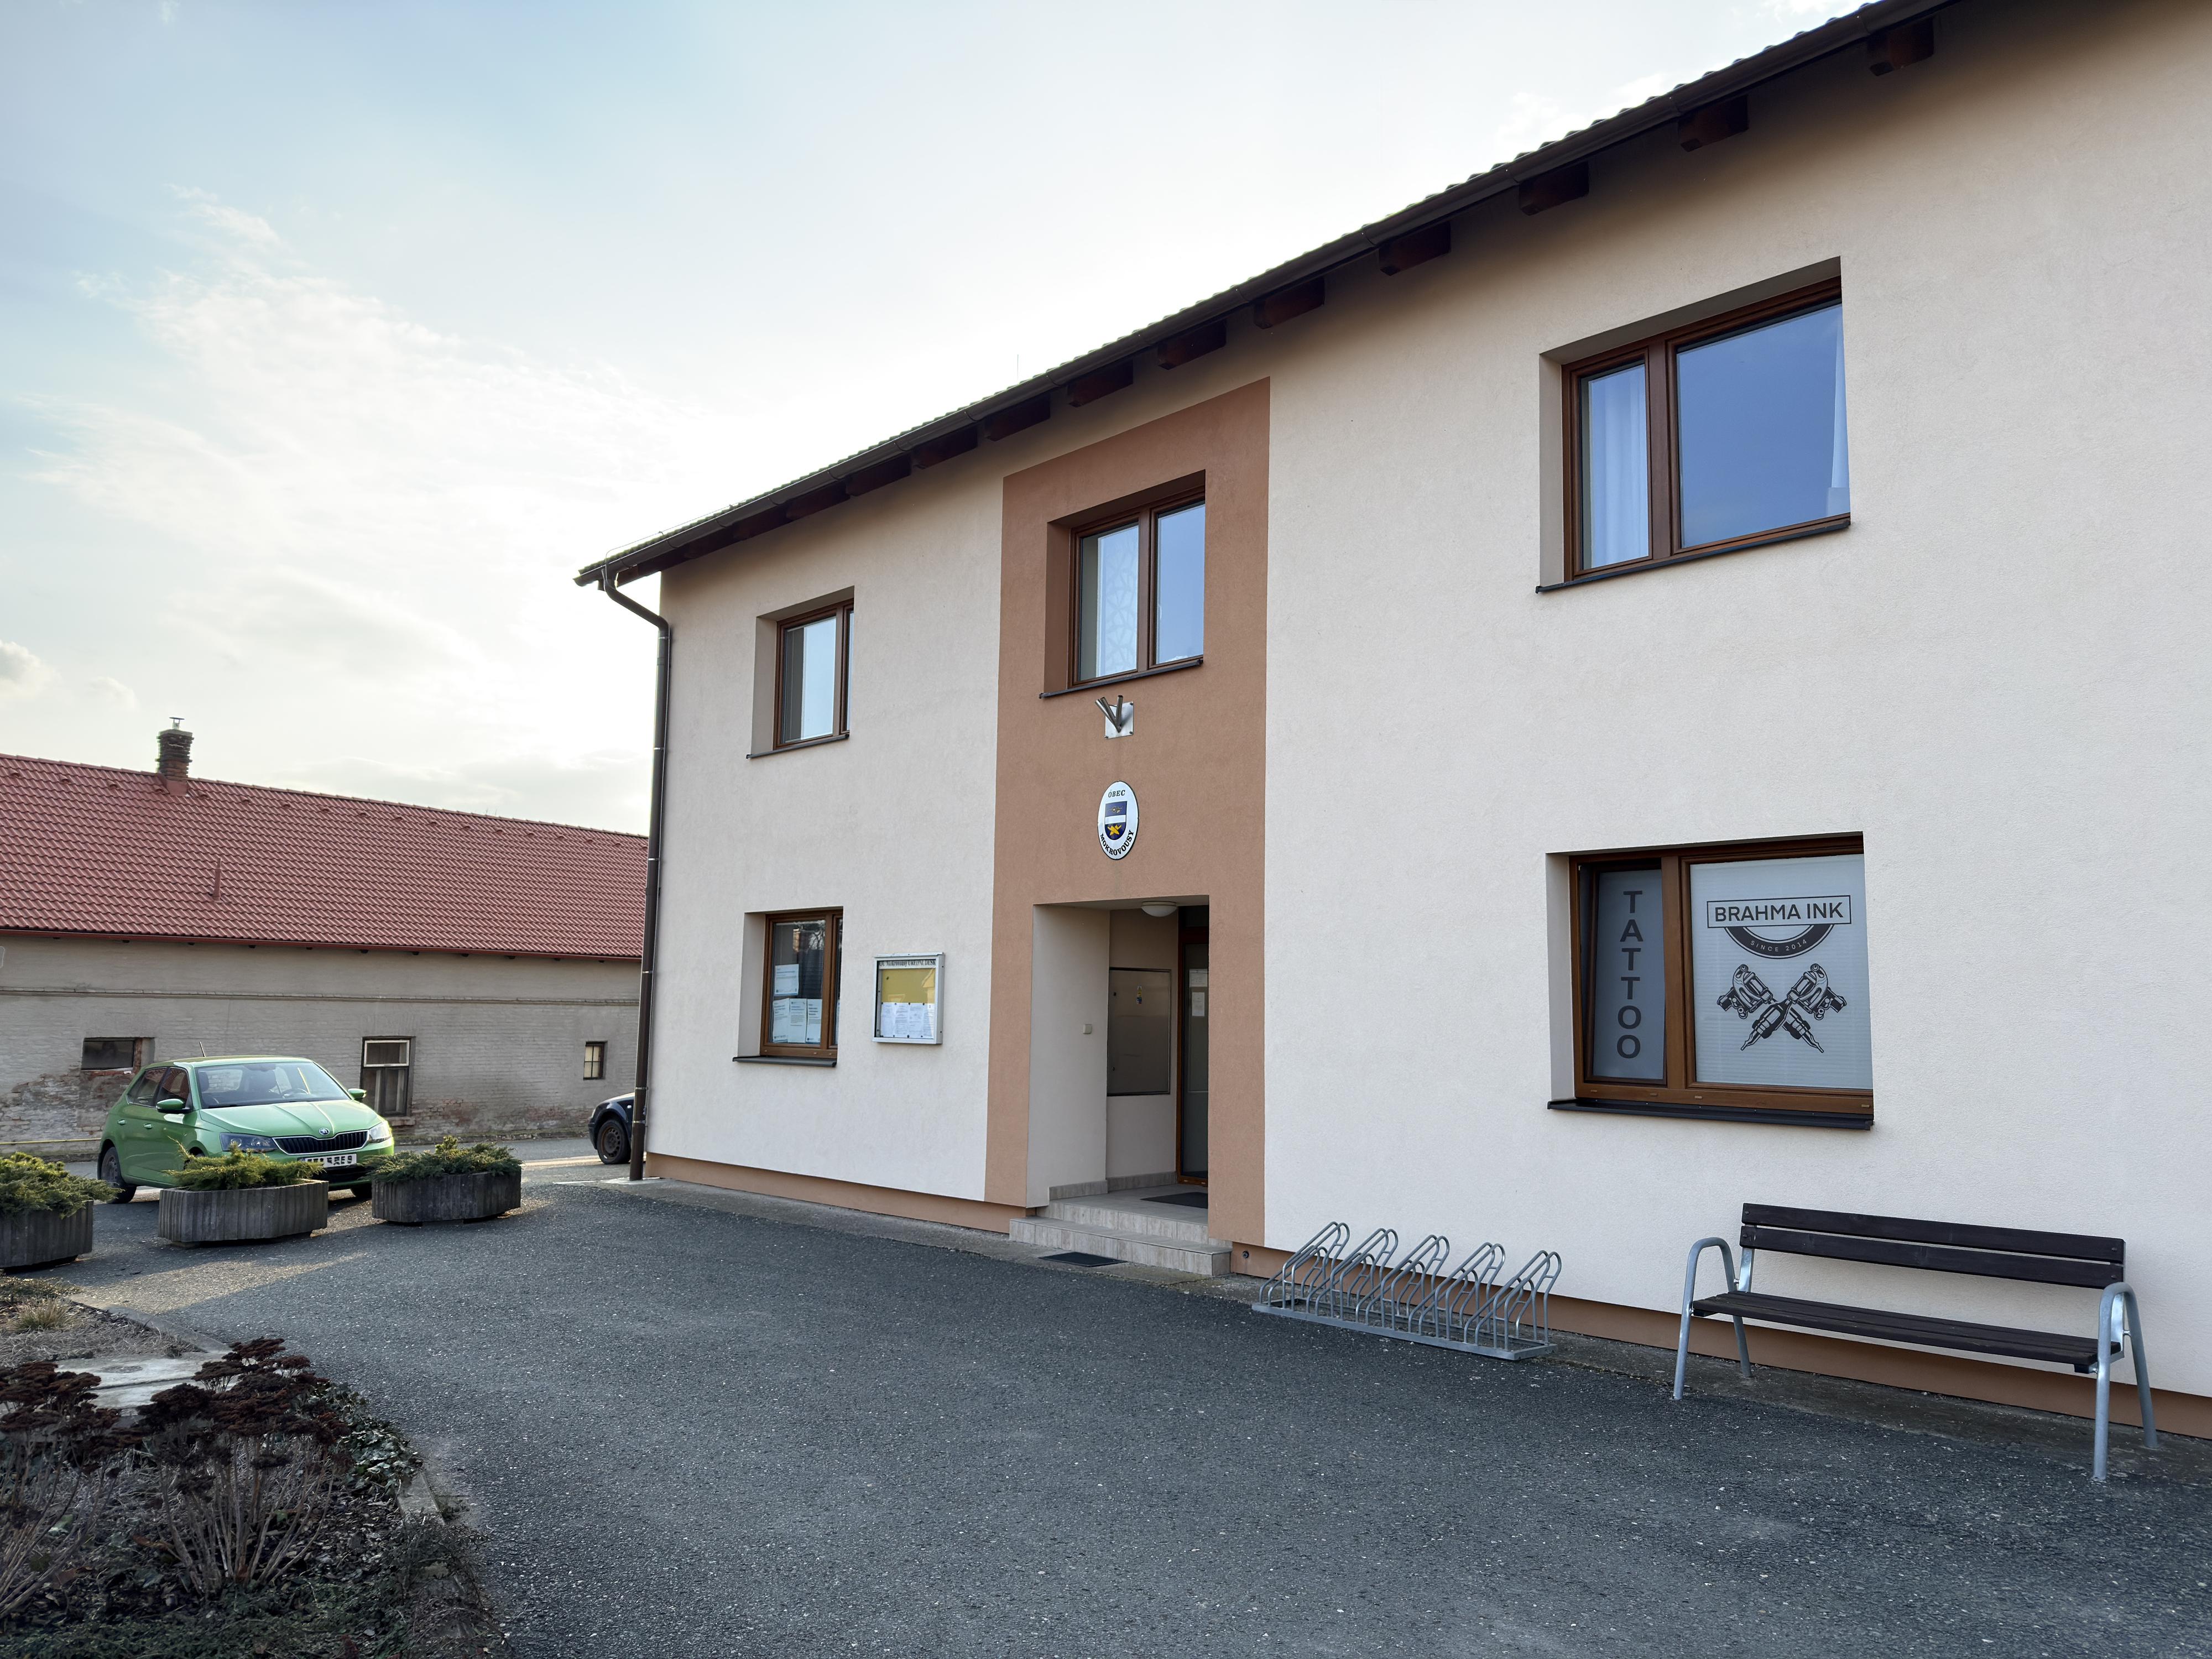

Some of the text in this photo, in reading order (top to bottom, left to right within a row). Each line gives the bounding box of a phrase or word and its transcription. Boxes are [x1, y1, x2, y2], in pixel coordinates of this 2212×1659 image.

[1108, 790, 1125, 798] OBEC
[1100, 830, 1134, 855] MOKROVOUSY
[1715, 902, 1844, 922] BRAHMA INK
[1750, 939, 1807, 952] SINCE 2014
[1616, 890, 1644, 1059] TATTOO
